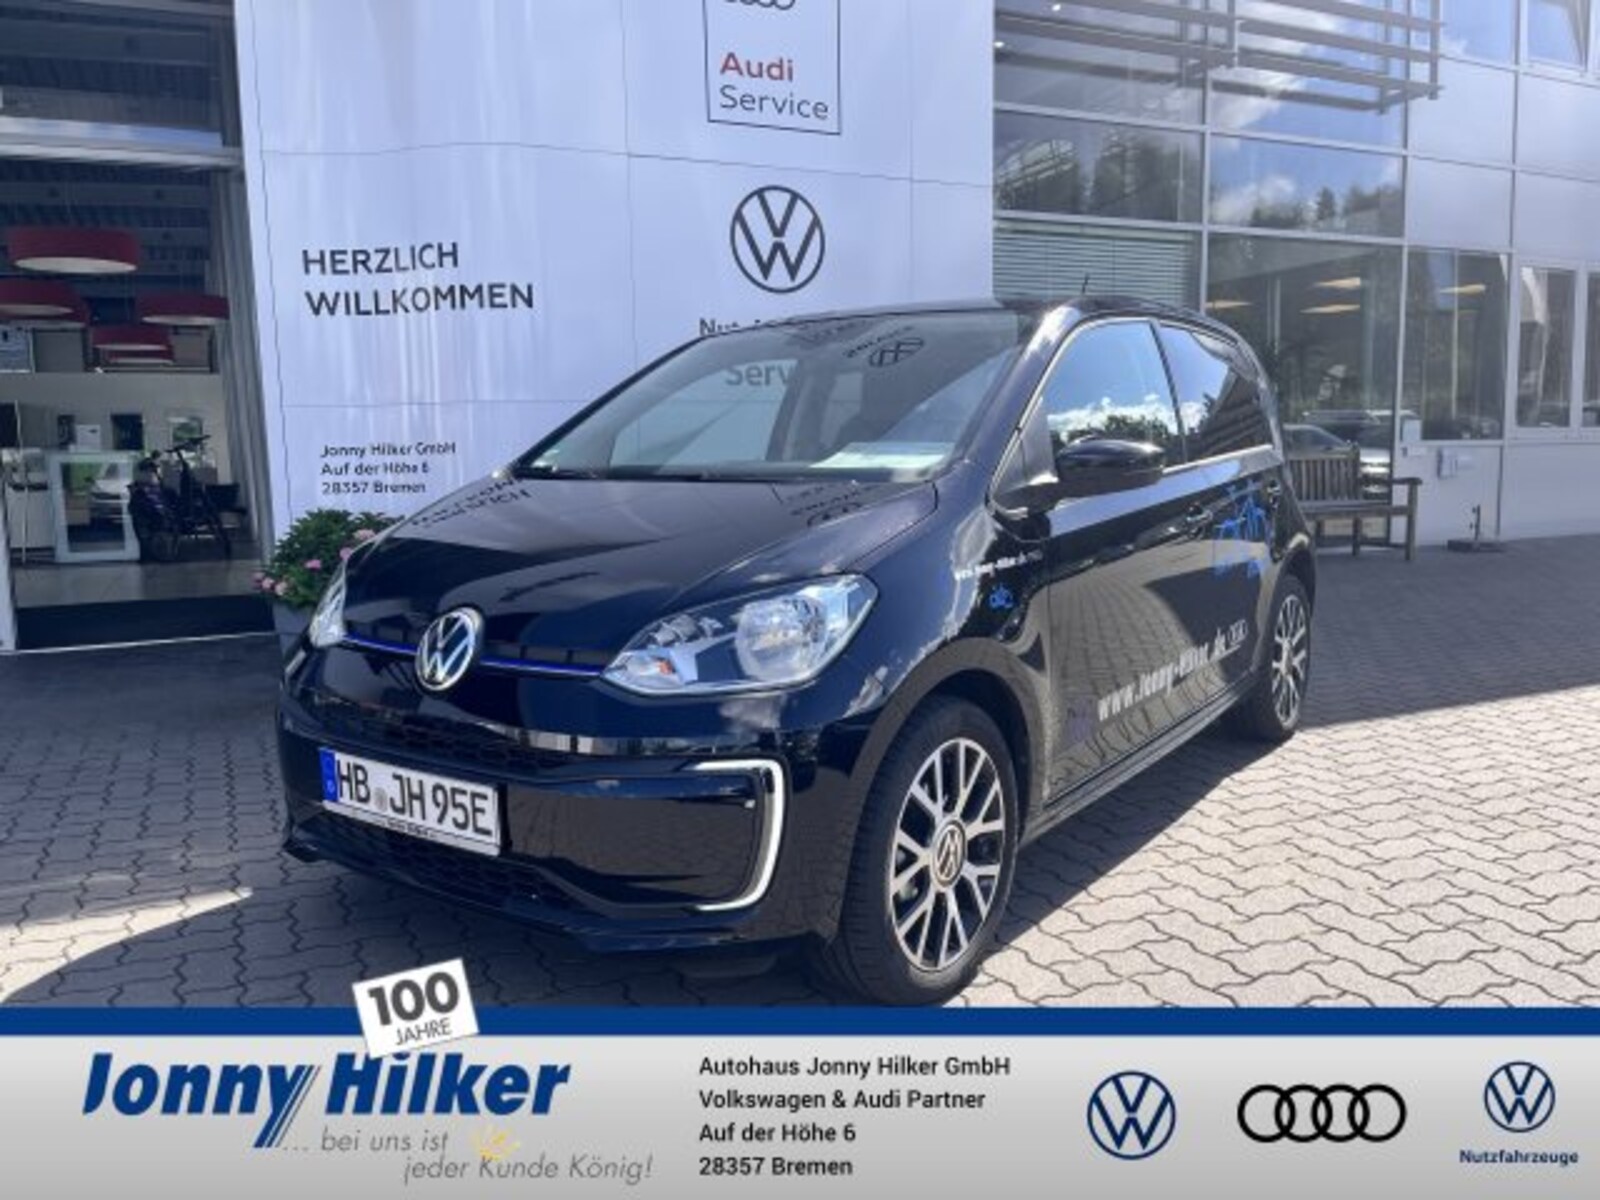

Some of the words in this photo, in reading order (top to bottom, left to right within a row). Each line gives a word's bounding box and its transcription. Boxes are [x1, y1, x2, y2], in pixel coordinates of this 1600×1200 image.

[720, 52, 794, 82] Audi
[719, 84, 829, 121] Service
[301, 241, 459, 276] HERZLICH
[304, 282, 534, 317] WILLKOMMEN
[320, 443, 366, 459] Jonny
[370, 442, 412, 456] Hilker
[414, 441, 457, 456] GmbH
[321, 461, 351, 476] Auf
[354, 461, 380, 476] der
[321, 480, 369, 495] 28357
[372, 480, 427, 494] Bremen
[336, 759, 371, 804] HB
[389, 771, 427, 821] JH
[431, 782, 493, 837] 95E
